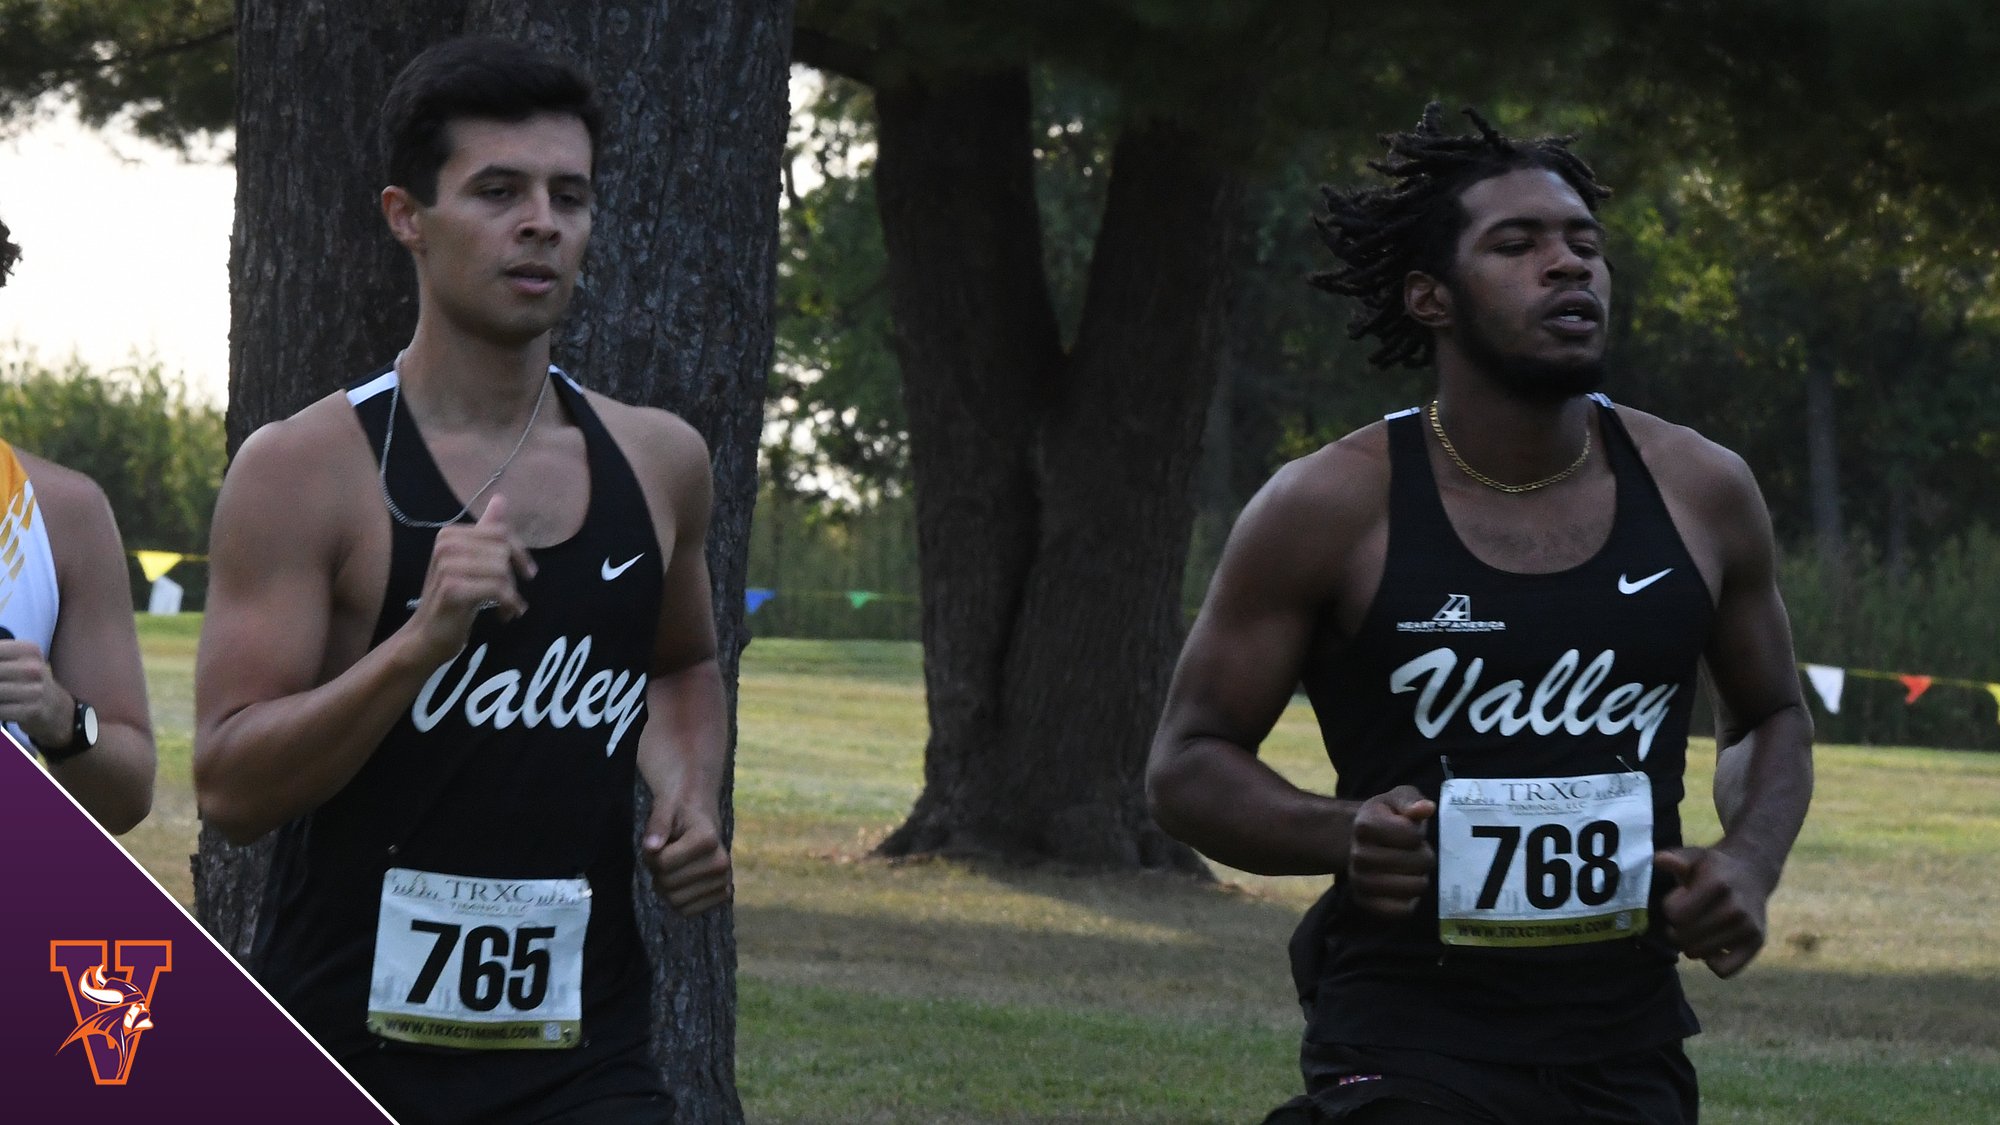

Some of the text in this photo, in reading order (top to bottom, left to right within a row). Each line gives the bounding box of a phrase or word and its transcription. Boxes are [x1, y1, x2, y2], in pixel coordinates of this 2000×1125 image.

[1450, 621, 1506, 630] AMERICA
[411, 634, 647, 758] Valley
[1390, 647, 1679, 762] Valley
[1501, 780, 1591, 801] TRXC
[445, 880, 534, 902] TRXC
[1471, 820, 1620, 910] 768
[405, 919, 556, 1012] 765
